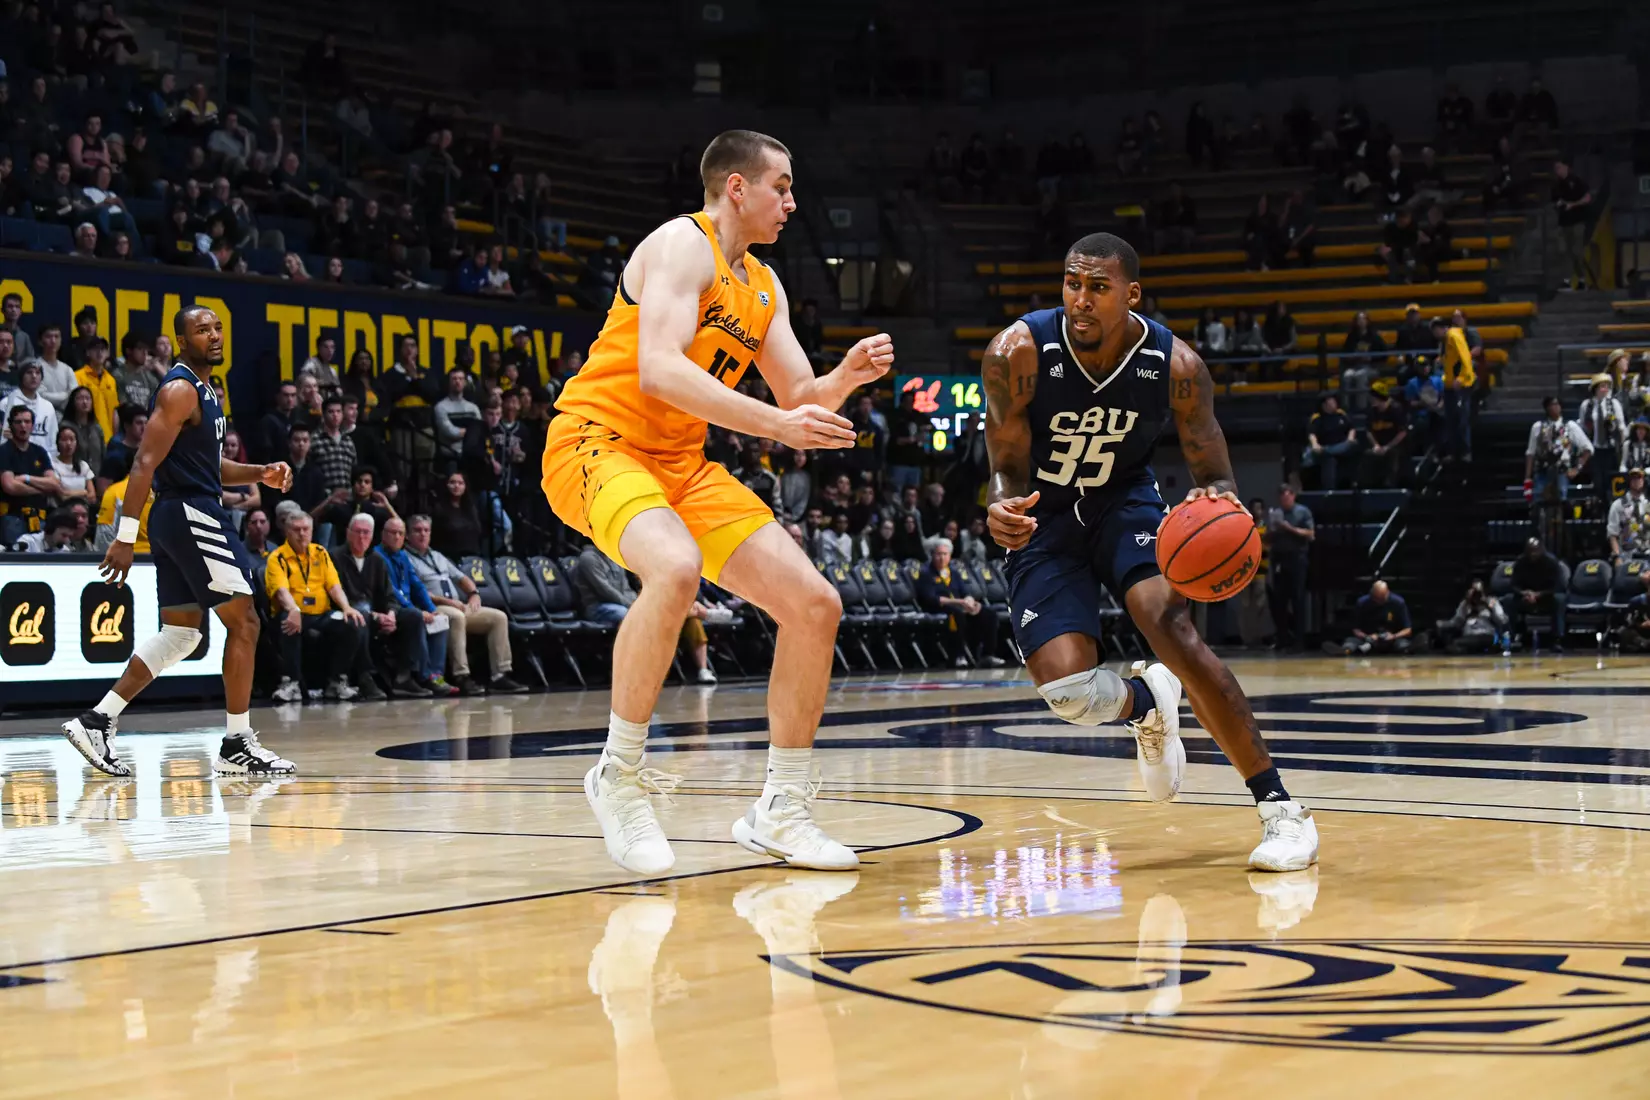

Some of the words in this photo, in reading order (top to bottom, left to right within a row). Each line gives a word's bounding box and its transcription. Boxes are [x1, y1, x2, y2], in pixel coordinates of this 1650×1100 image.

[701, 301, 746, 339] Golden
[1136, 367, 1159, 380] WAC
[951, 383, 982, 408] 14
[1049, 406, 1139, 436] CBU
[1036, 434, 1126, 488] 35
[9, 601, 46, 645] Cal
[90, 600, 125, 644] Cal
